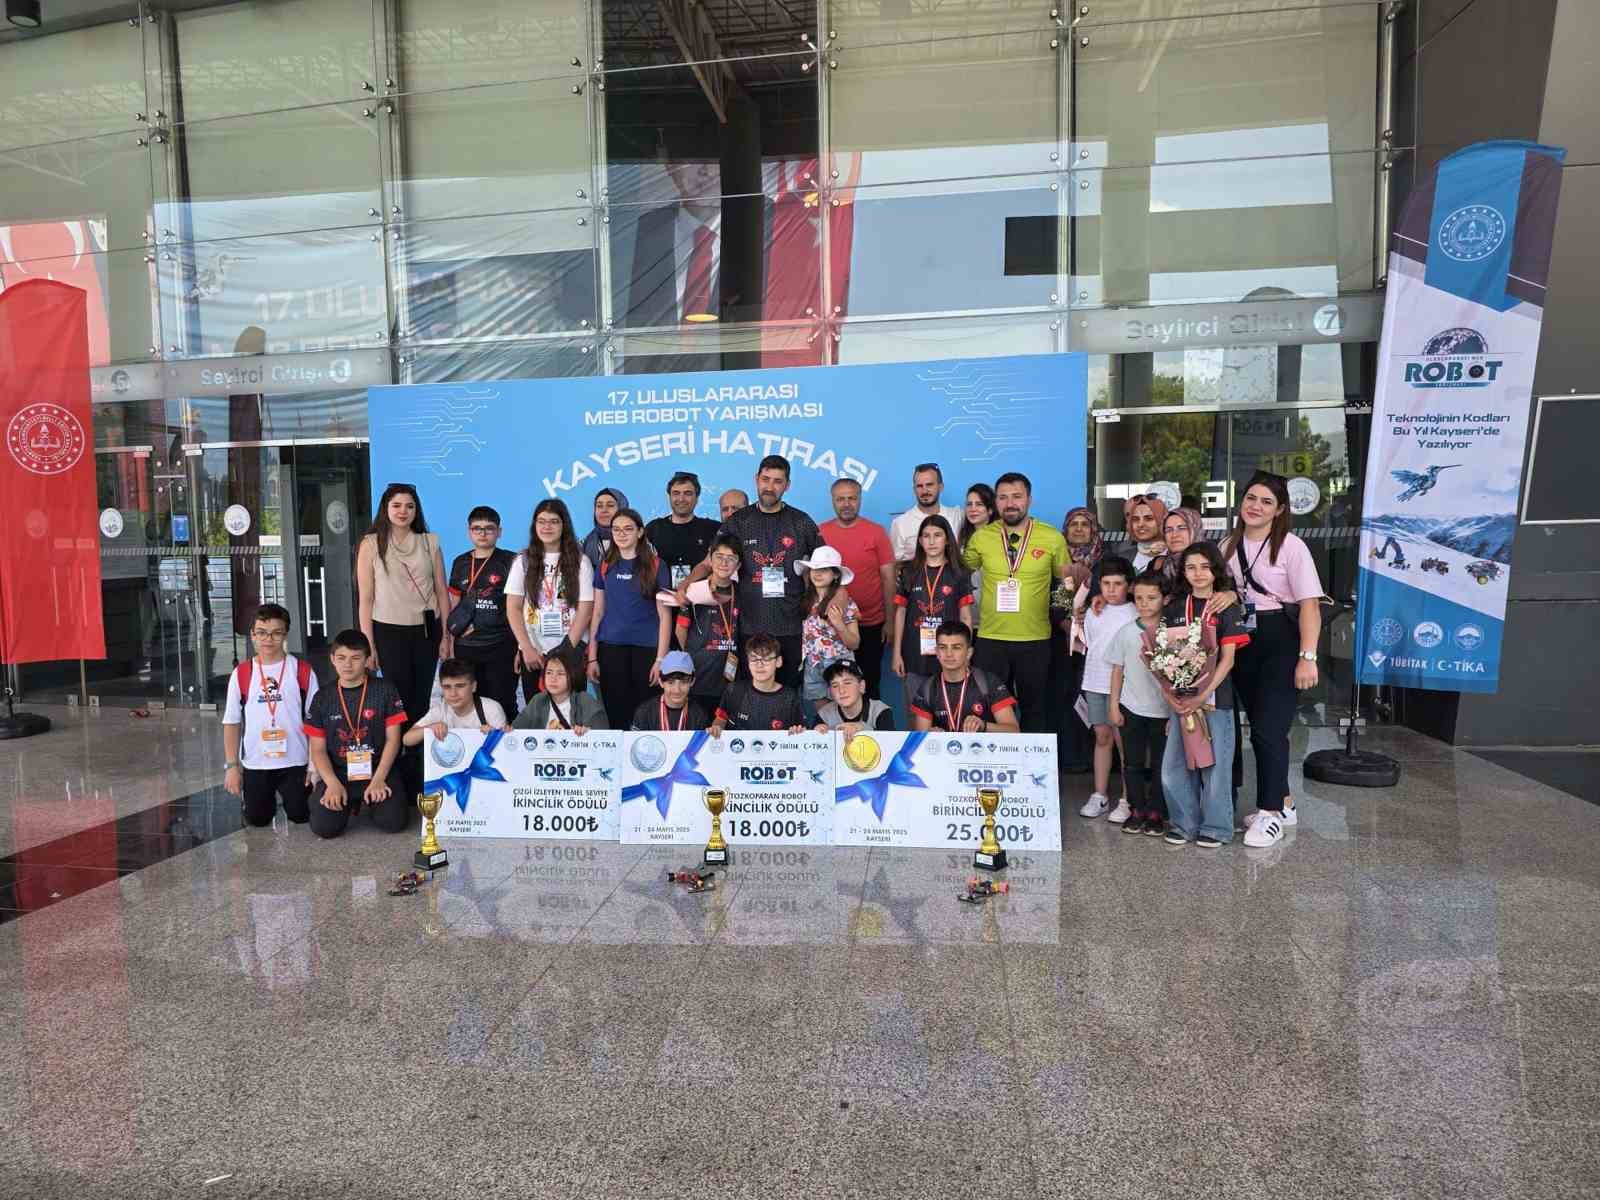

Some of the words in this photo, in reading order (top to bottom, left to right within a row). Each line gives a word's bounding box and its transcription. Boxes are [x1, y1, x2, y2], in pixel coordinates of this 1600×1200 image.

[1404, 361, 1503, 383] ROBOT
[607, 390, 634, 406] 17.
[637, 383, 799, 405] ULUSLARARASI
[585, 410, 628, 426] MEB
[632, 407, 702, 424] ROBOT
[705, 402, 824, 424] YARIŞMASI
[1386, 413, 1462, 425] Teknolojinin
[1462, 413, 1511, 423] Kodları
[1392, 426, 1410, 436] Bu
[1413, 426, 1429, 436] Yıl
[1430, 426, 1501, 438] Kayseri'de
[1417, 439, 1473, 451] Yazılıyor
[542, 425, 697, 498] KAYSERİ
[702, 429, 880, 492] HATIRASI
[534, 764, 587, 777] ROBOT
[740, 766, 797, 781] ROBOT
[958, 769, 1018, 783] ROBOT
[513, 795, 564, 809] İKİNCİLİK
[567, 796, 608, 810] ÖDÜLÜ
[781, 792, 807, 800] ROBOT
[724, 801, 773, 813] KİNCİLİK
[776, 800, 819, 814] ÖDÜLÜ
[1000, 804, 1046, 818] ÖDÜLÜ
[523, 814, 600, 833] 18.000₺
[729, 820, 810, 838] 18.000₺
